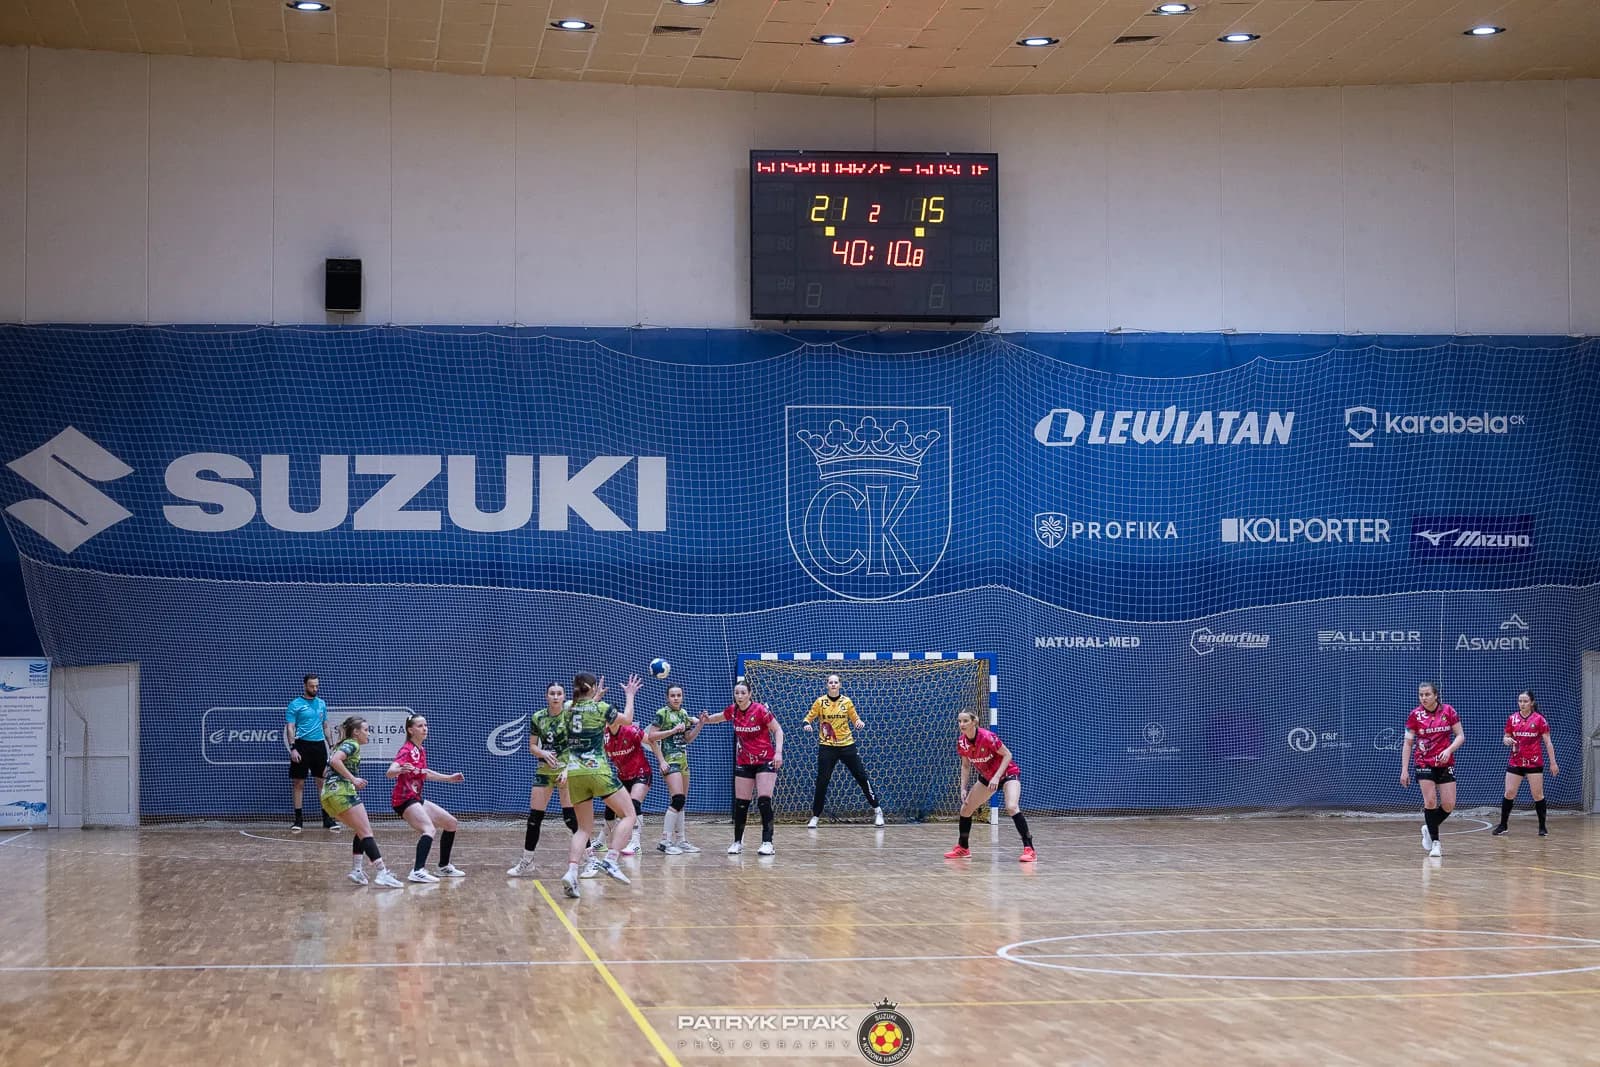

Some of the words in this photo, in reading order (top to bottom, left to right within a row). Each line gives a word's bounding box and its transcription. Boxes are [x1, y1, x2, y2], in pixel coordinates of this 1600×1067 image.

[811, 195, 849, 222] 21
[869, 204, 881, 223] 2
[920, 196, 945, 223] 15
[1087, 404, 1296, 445] LEWIATAN
[1385, 411, 1508, 434] karabela
[1509, 414, 1526, 425] CK
[162, 451, 667, 533] SUZUKI
[804, 482, 921, 576] CK
[1072, 520, 1179, 540] PROFIKA
[1239, 517, 1392, 543] KOLPORTER
[1034, 636, 1140, 648] NATURAL-MED
[1198, 632, 1270, 643] endorfina
[1332, 631, 1421, 642] ALUTOR
[1455, 634, 1530, 651] Aswent
[572, 714, 583, 733] 5
[228, 730, 280, 743] PGNiG
[546, 731, 555, 742] 3
